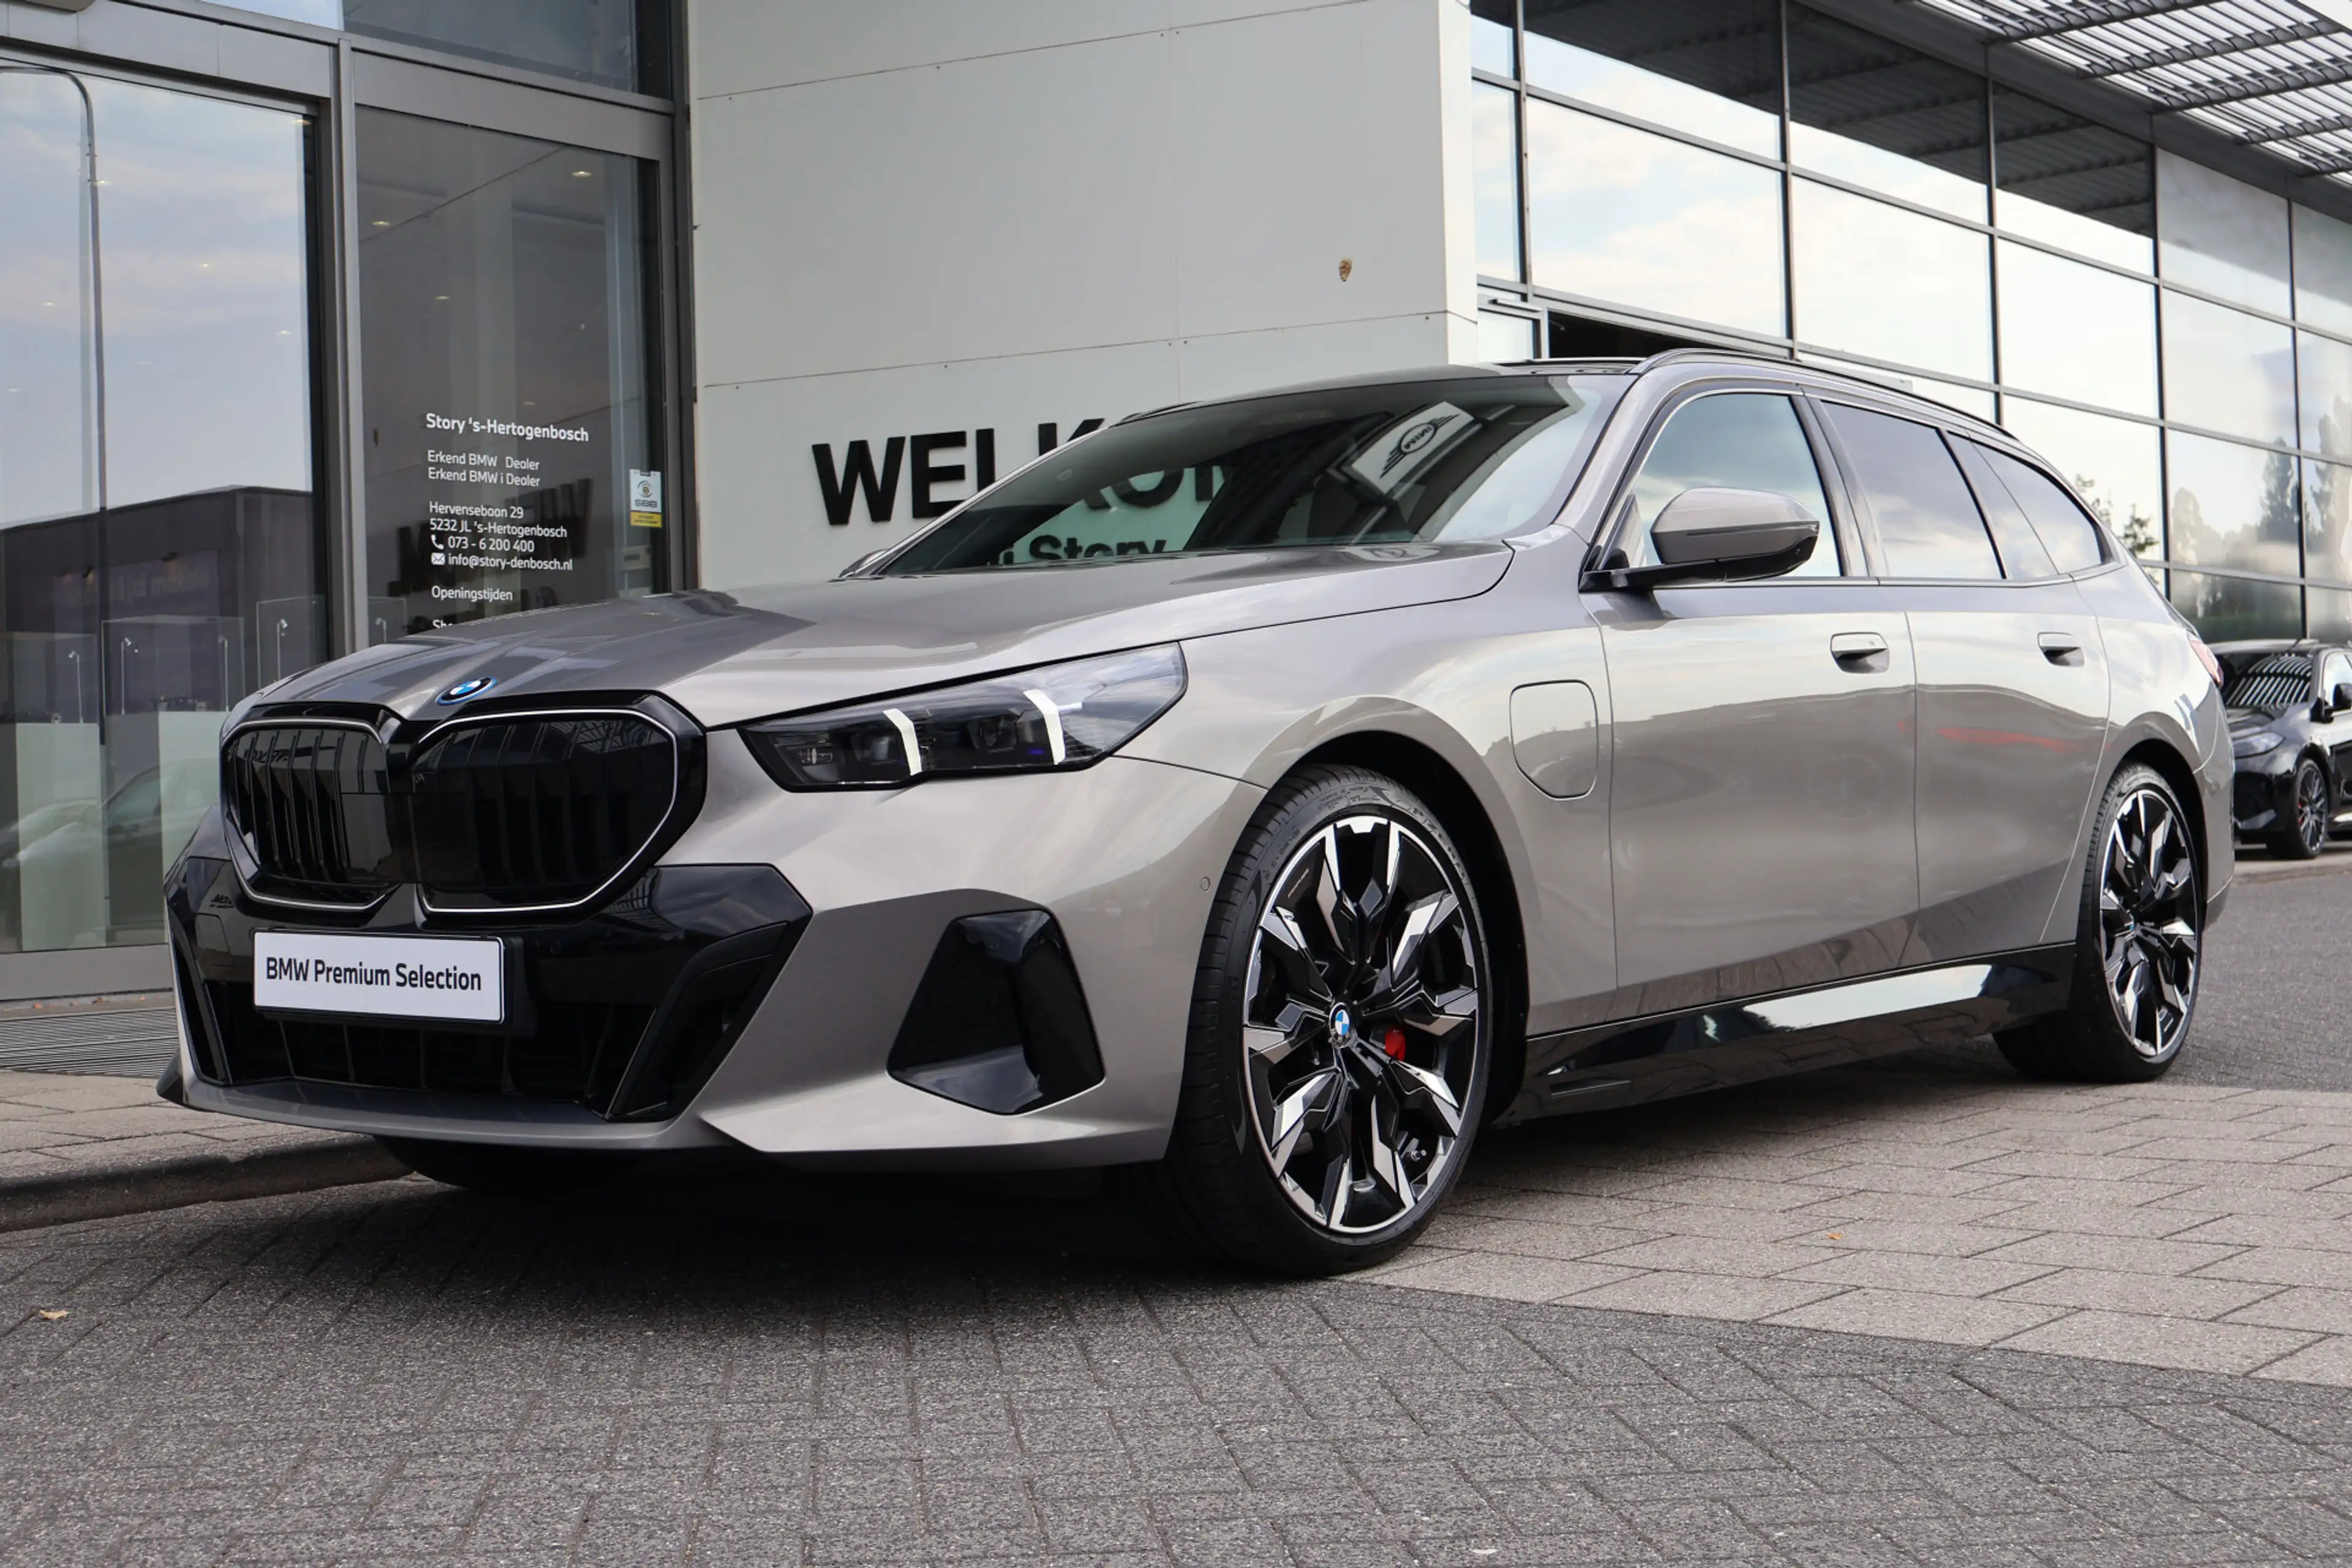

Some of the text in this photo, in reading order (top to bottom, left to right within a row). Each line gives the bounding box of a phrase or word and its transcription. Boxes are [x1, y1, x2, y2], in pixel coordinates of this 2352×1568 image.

[426, 412, 589, 442] Story 's-Hertogenbosch
[427, 449, 540, 470] Erkend BMW Dealer
[428, 466, 541, 488] Erkend BMW i Dealer
[429, 500, 524, 519] Hervensebaan 29
[429, 518, 568, 538] 5232 JL 's-Hertogenbosch
[447, 535, 469, 549] 073
[478, 537, 487, 550] 6
[488, 538, 511, 551] 200
[512, 539, 535, 552] 400
[448, 552, 573, 571] info@story-denbosch.nl
[431, 585, 513, 603] Openingstijden
[266, 956, 482, 991] BMW Premium Selection
